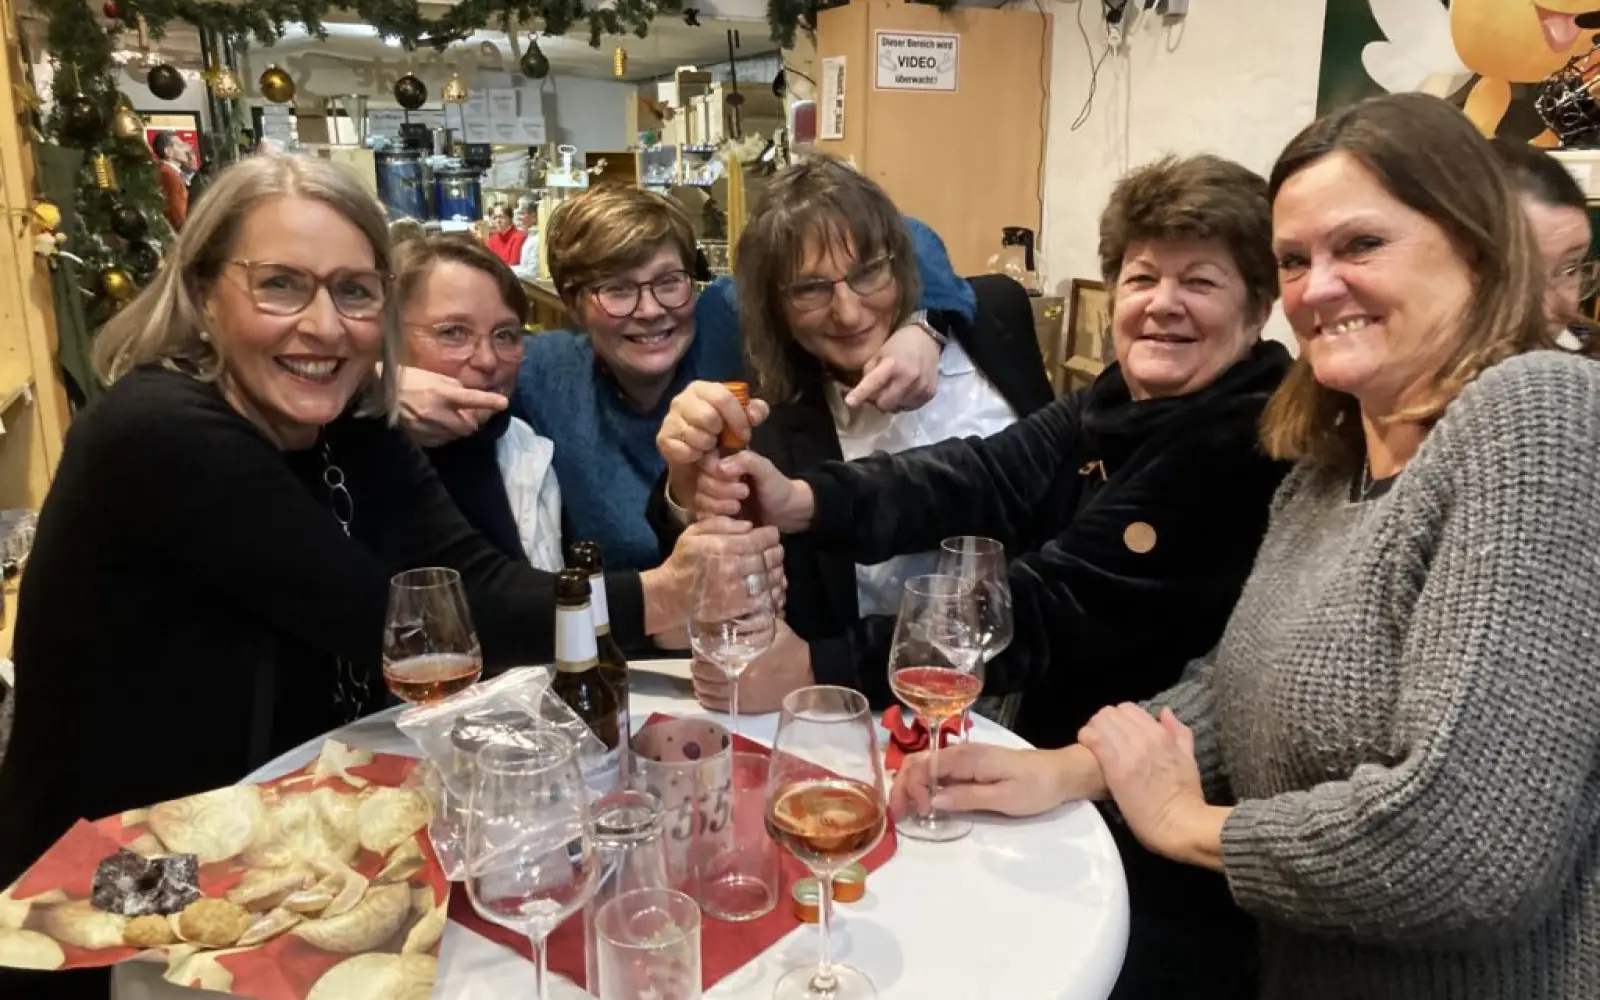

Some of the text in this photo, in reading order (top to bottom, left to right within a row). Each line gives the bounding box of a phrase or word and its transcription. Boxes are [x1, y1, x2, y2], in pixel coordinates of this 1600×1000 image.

[881, 36, 953, 50] Dieser Bereich wird
[897, 55, 937, 69] VIDEO
